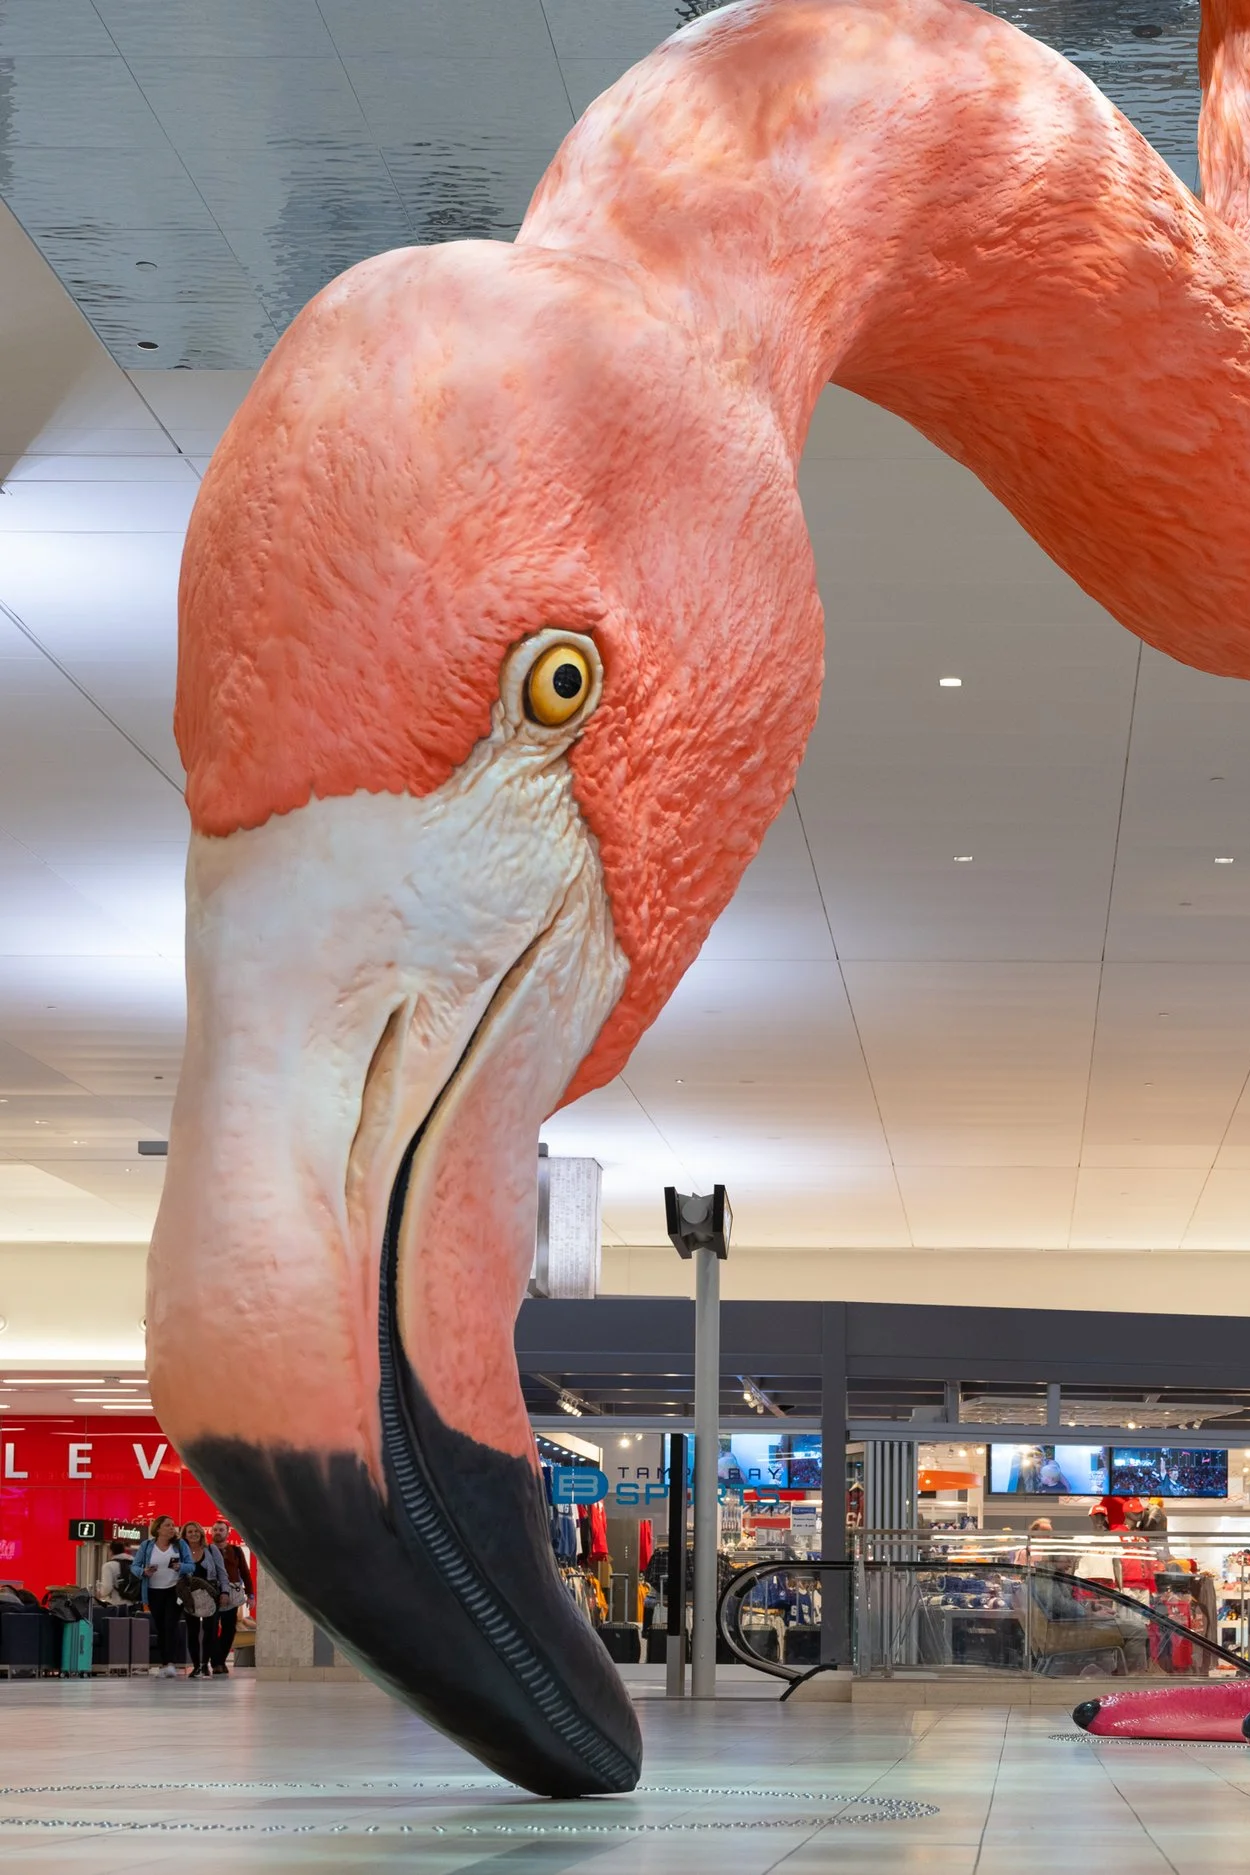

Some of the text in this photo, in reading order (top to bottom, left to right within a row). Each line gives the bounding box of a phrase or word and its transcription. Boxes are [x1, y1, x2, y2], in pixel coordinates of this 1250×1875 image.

[617, 1466, 780, 1480] TAM BAY
[117, 1525, 141, 1540] Information
